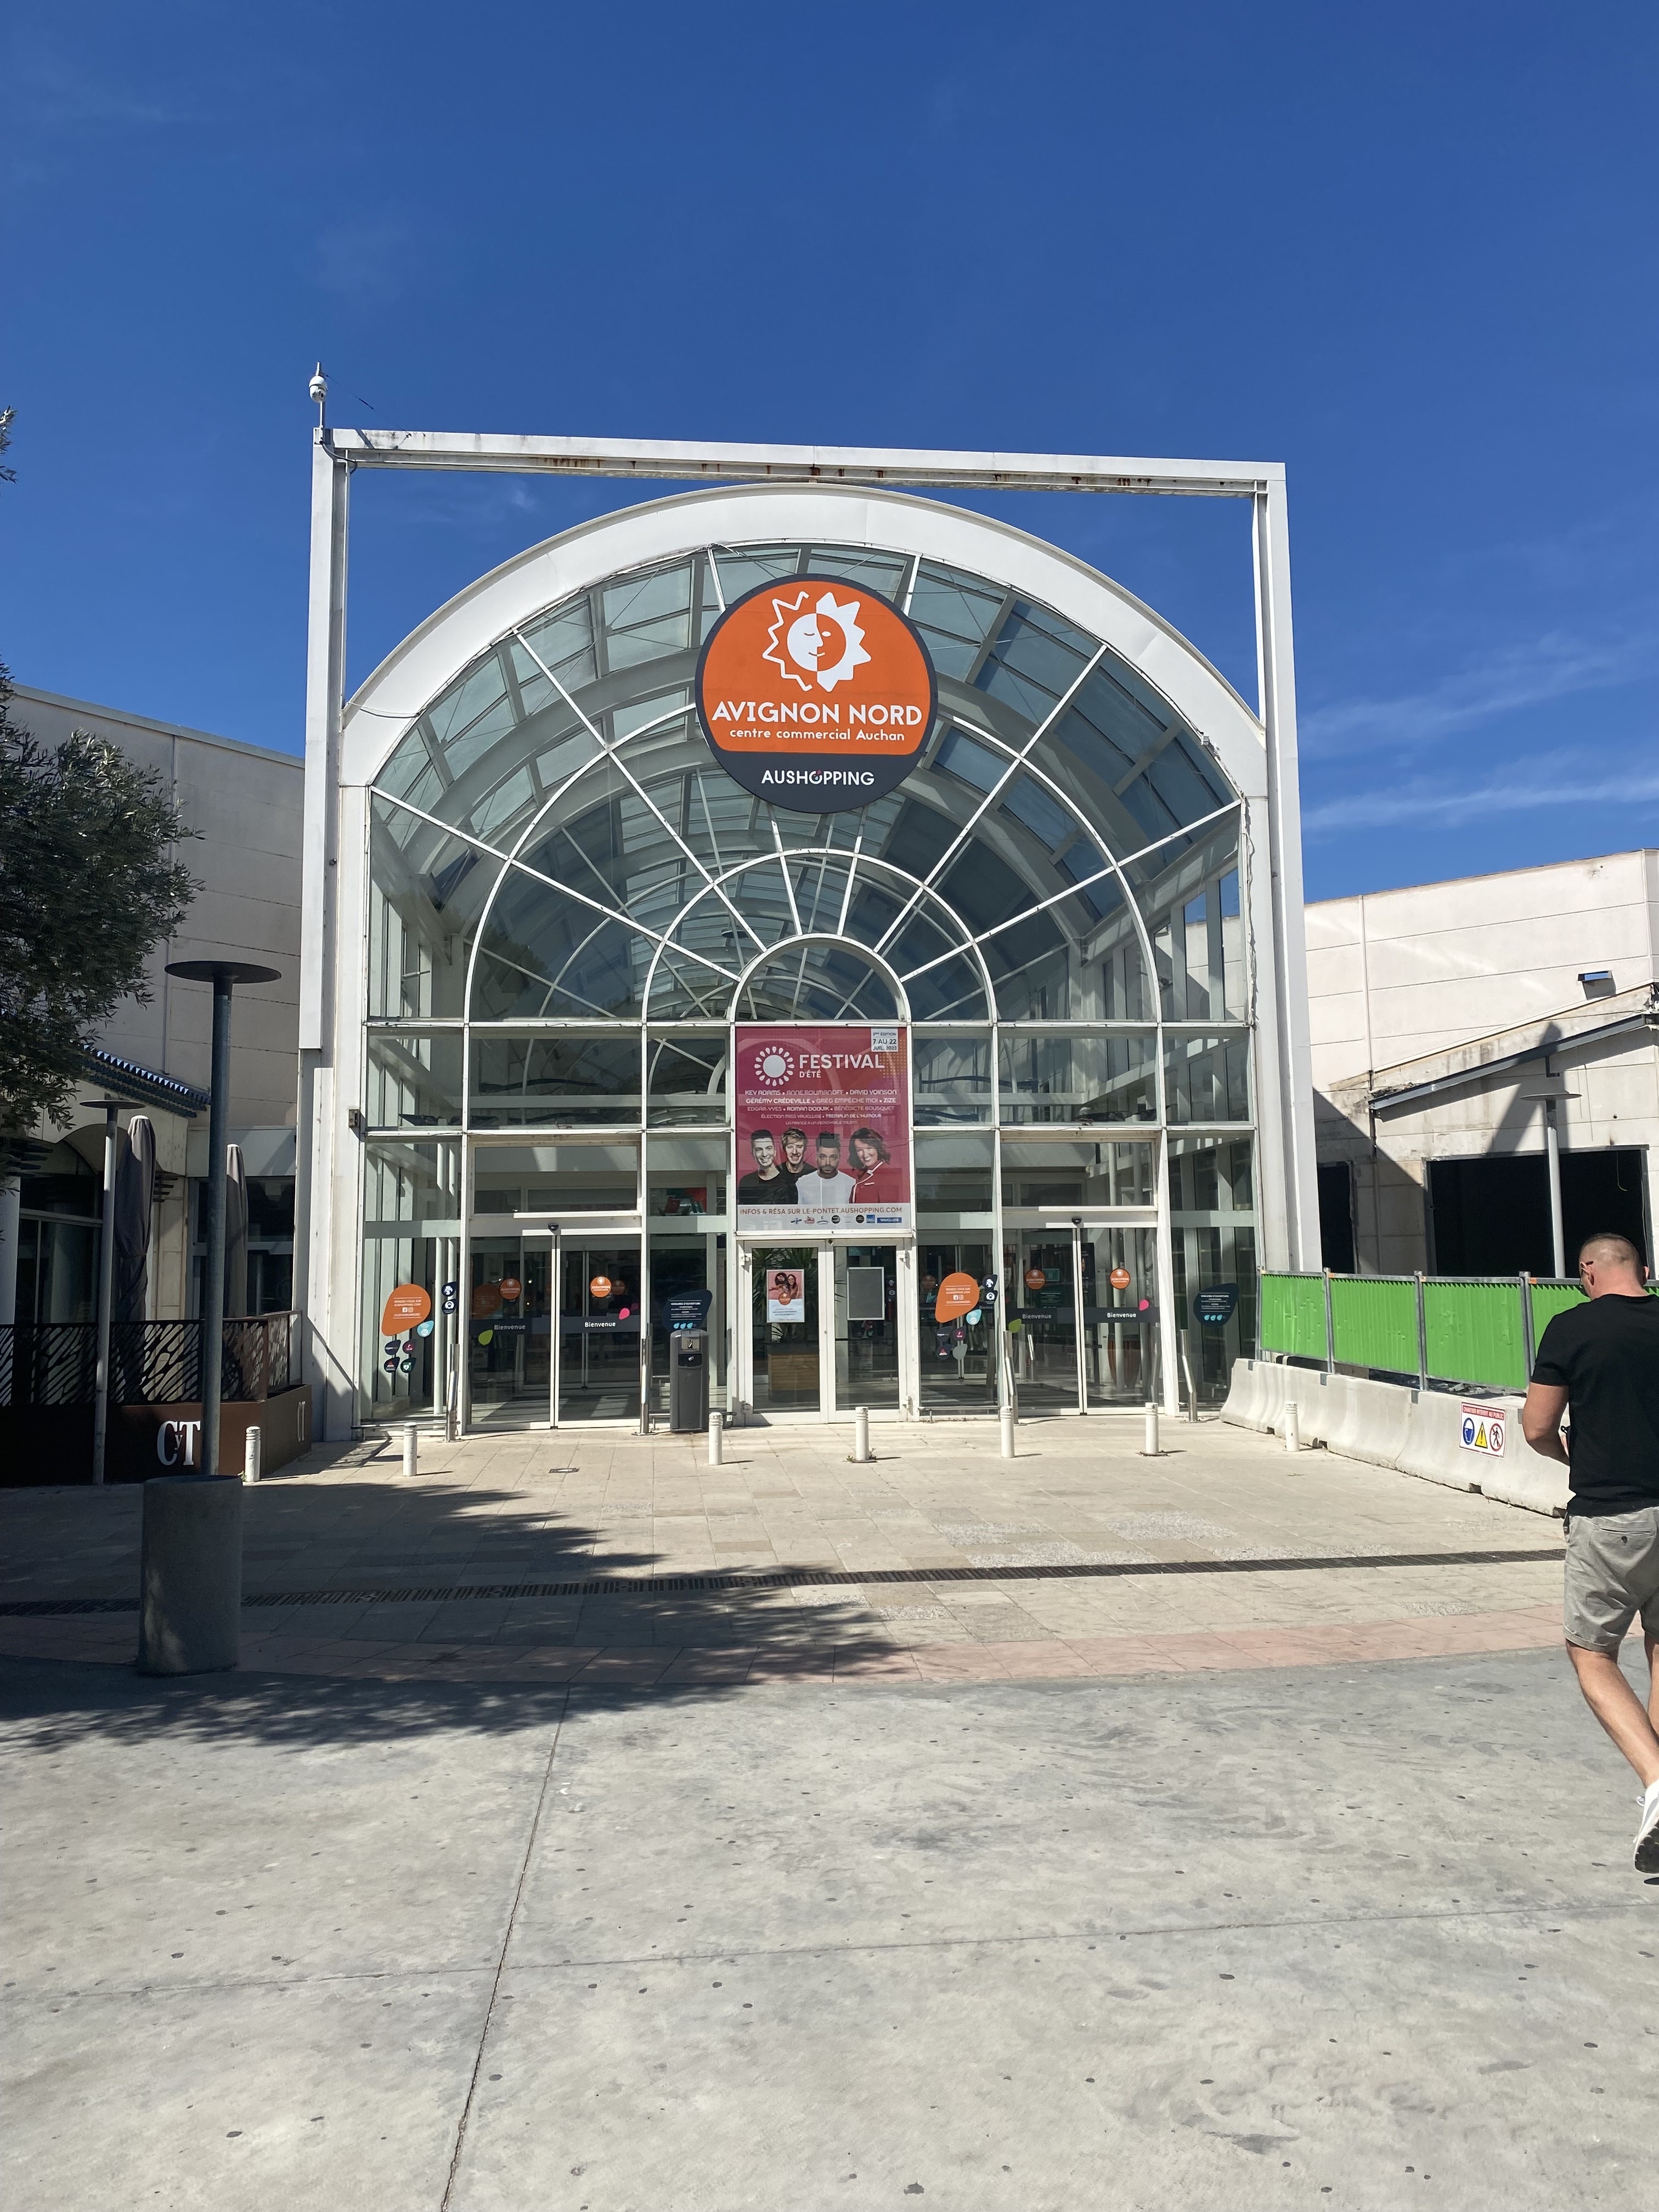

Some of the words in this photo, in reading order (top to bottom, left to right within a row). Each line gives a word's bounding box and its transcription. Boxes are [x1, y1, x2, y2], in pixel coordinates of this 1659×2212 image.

[712, 701, 839, 724] AVIGNON
[849, 704, 922, 725] NORD
[730, 728, 771, 738] centre
[776, 729, 850, 740] commercial
[856, 729, 905, 741] Auchan
[761, 770, 874, 786] AUSHOPPING
[799, 1054, 885, 1069] FESTIVAL
[799, 1070, 821, 1078] D'ÉTÉ
